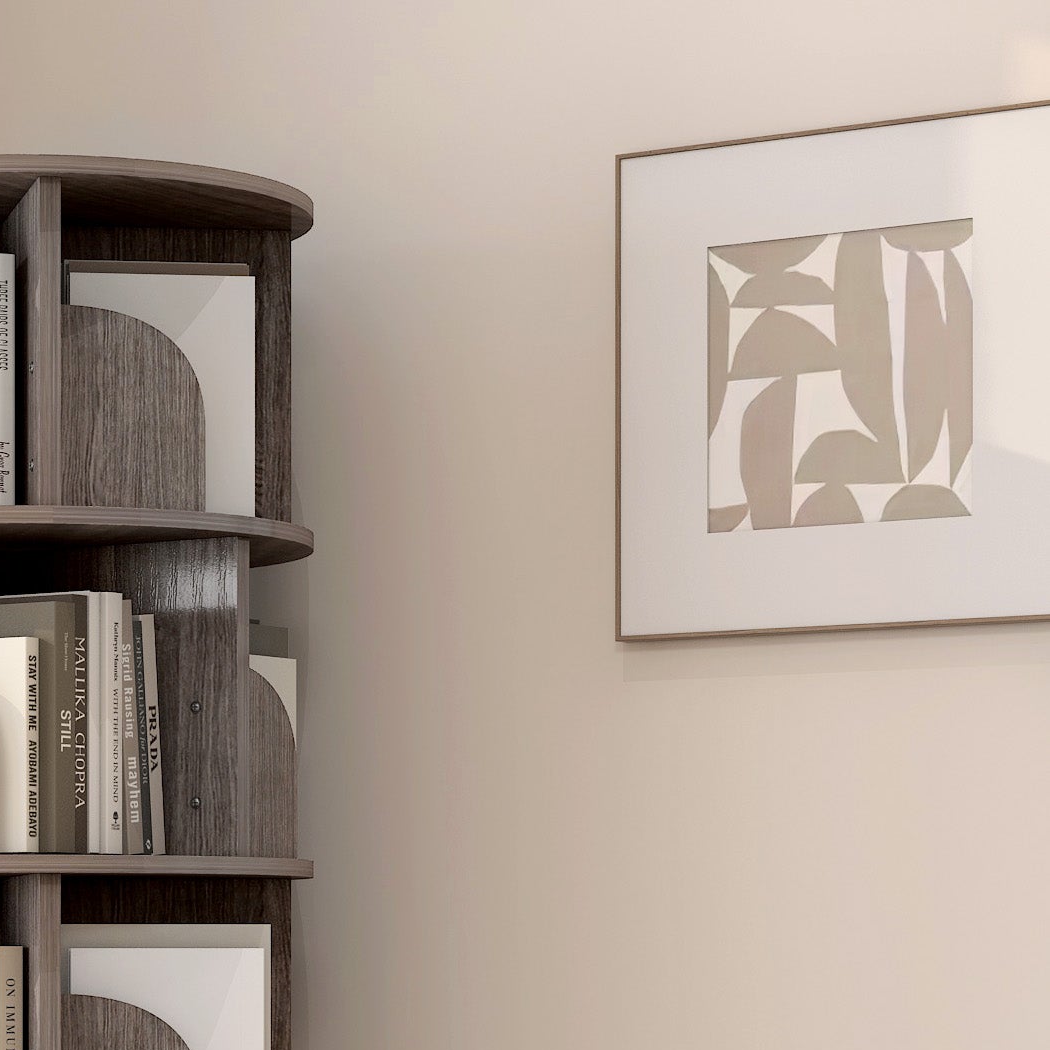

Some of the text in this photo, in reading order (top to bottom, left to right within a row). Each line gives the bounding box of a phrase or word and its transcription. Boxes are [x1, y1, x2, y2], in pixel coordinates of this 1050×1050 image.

[75, 637, 86, 809] MALLIKA CHOPRA
[121, 644, 135, 738] Sigrid Rausing
[135, 636, 149, 784] JOHN GALLIANO for DIOR
[28, 655, 37, 837] STAY WITH ME AYOBAMI ADEBAYO
[60, 710, 72, 752] STILL
[148, 705, 159, 772] PRADA
[113, 761, 119, 773] IN
[127, 756, 141, 824] mayhem
[6, 978, 16, 997] ON
